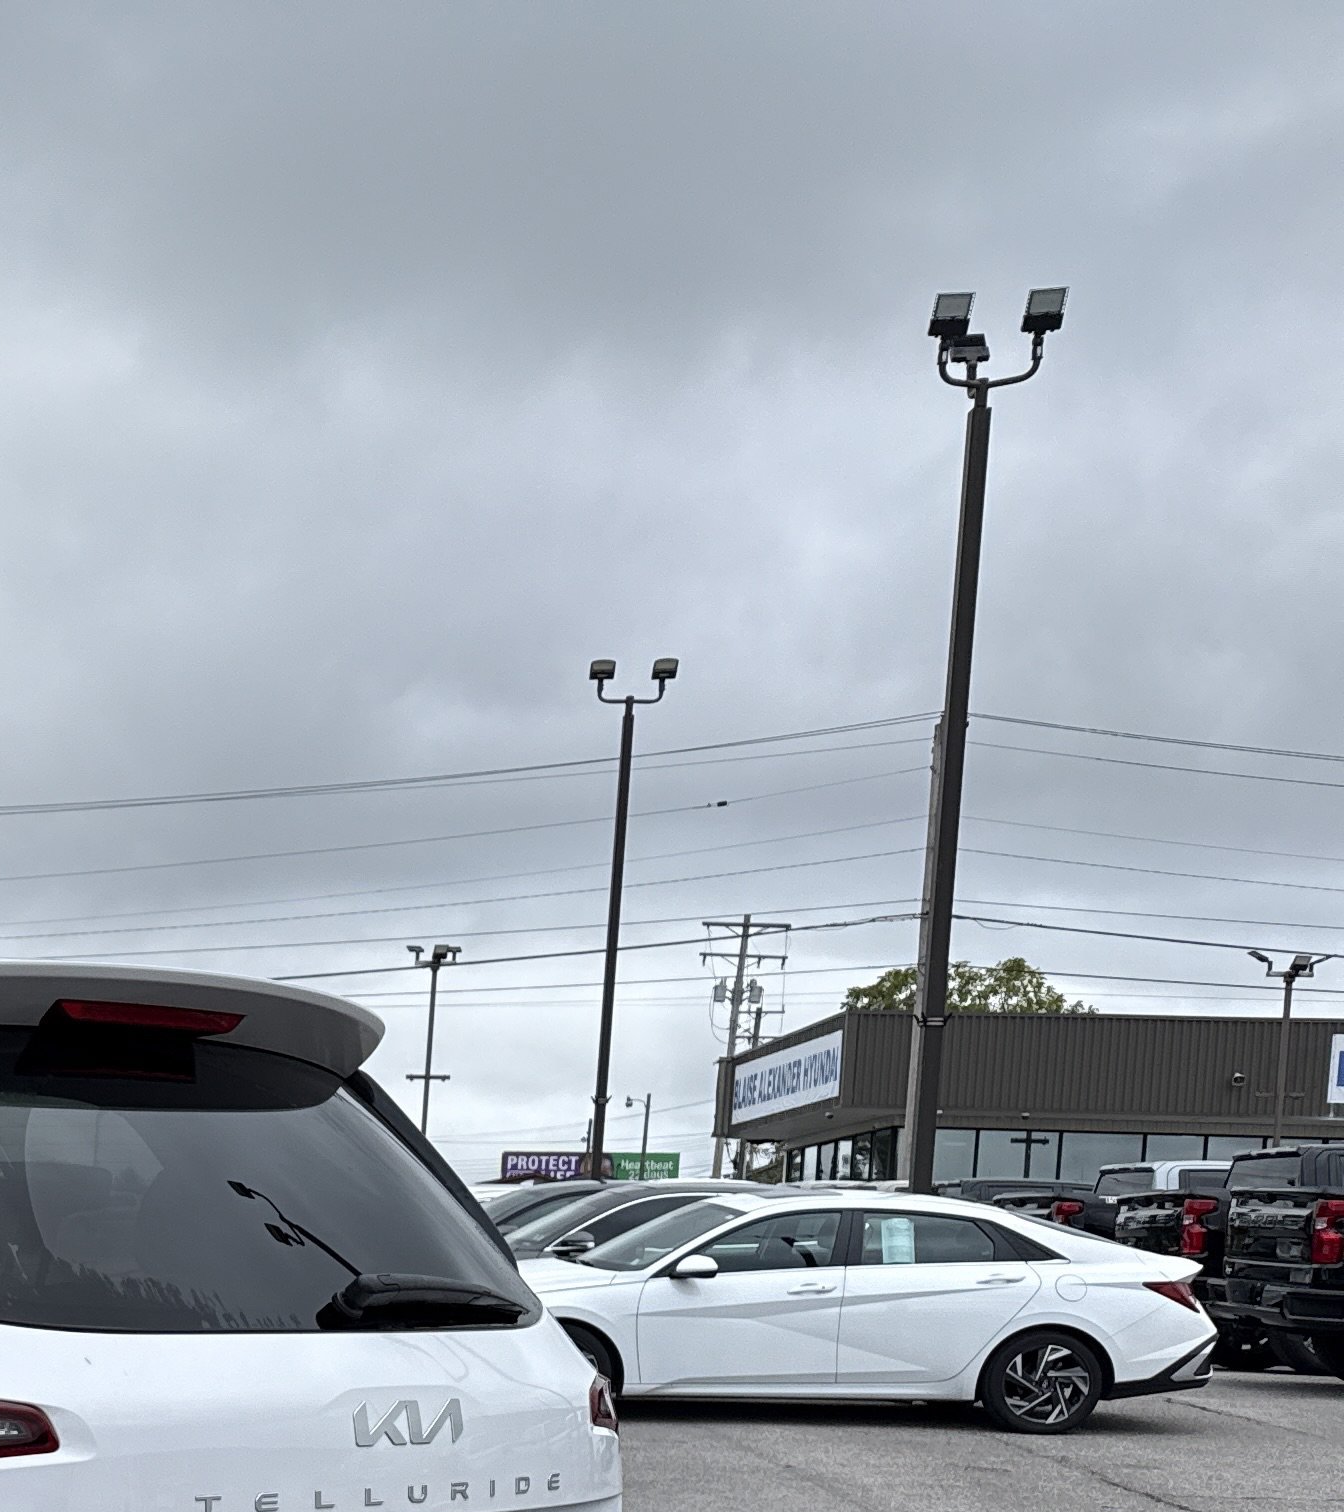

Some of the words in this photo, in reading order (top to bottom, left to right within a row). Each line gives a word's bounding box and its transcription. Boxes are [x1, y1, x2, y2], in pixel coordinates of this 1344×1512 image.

[757, 1059, 802, 1105] ALEXANDER
[802, 1046, 839, 1092] HYUNDAI
[506, 1155, 579, 1170] PROTECT
[620, 1159, 674, 1171] Heatbeat
[352, 1398, 463, 1447] KIA
